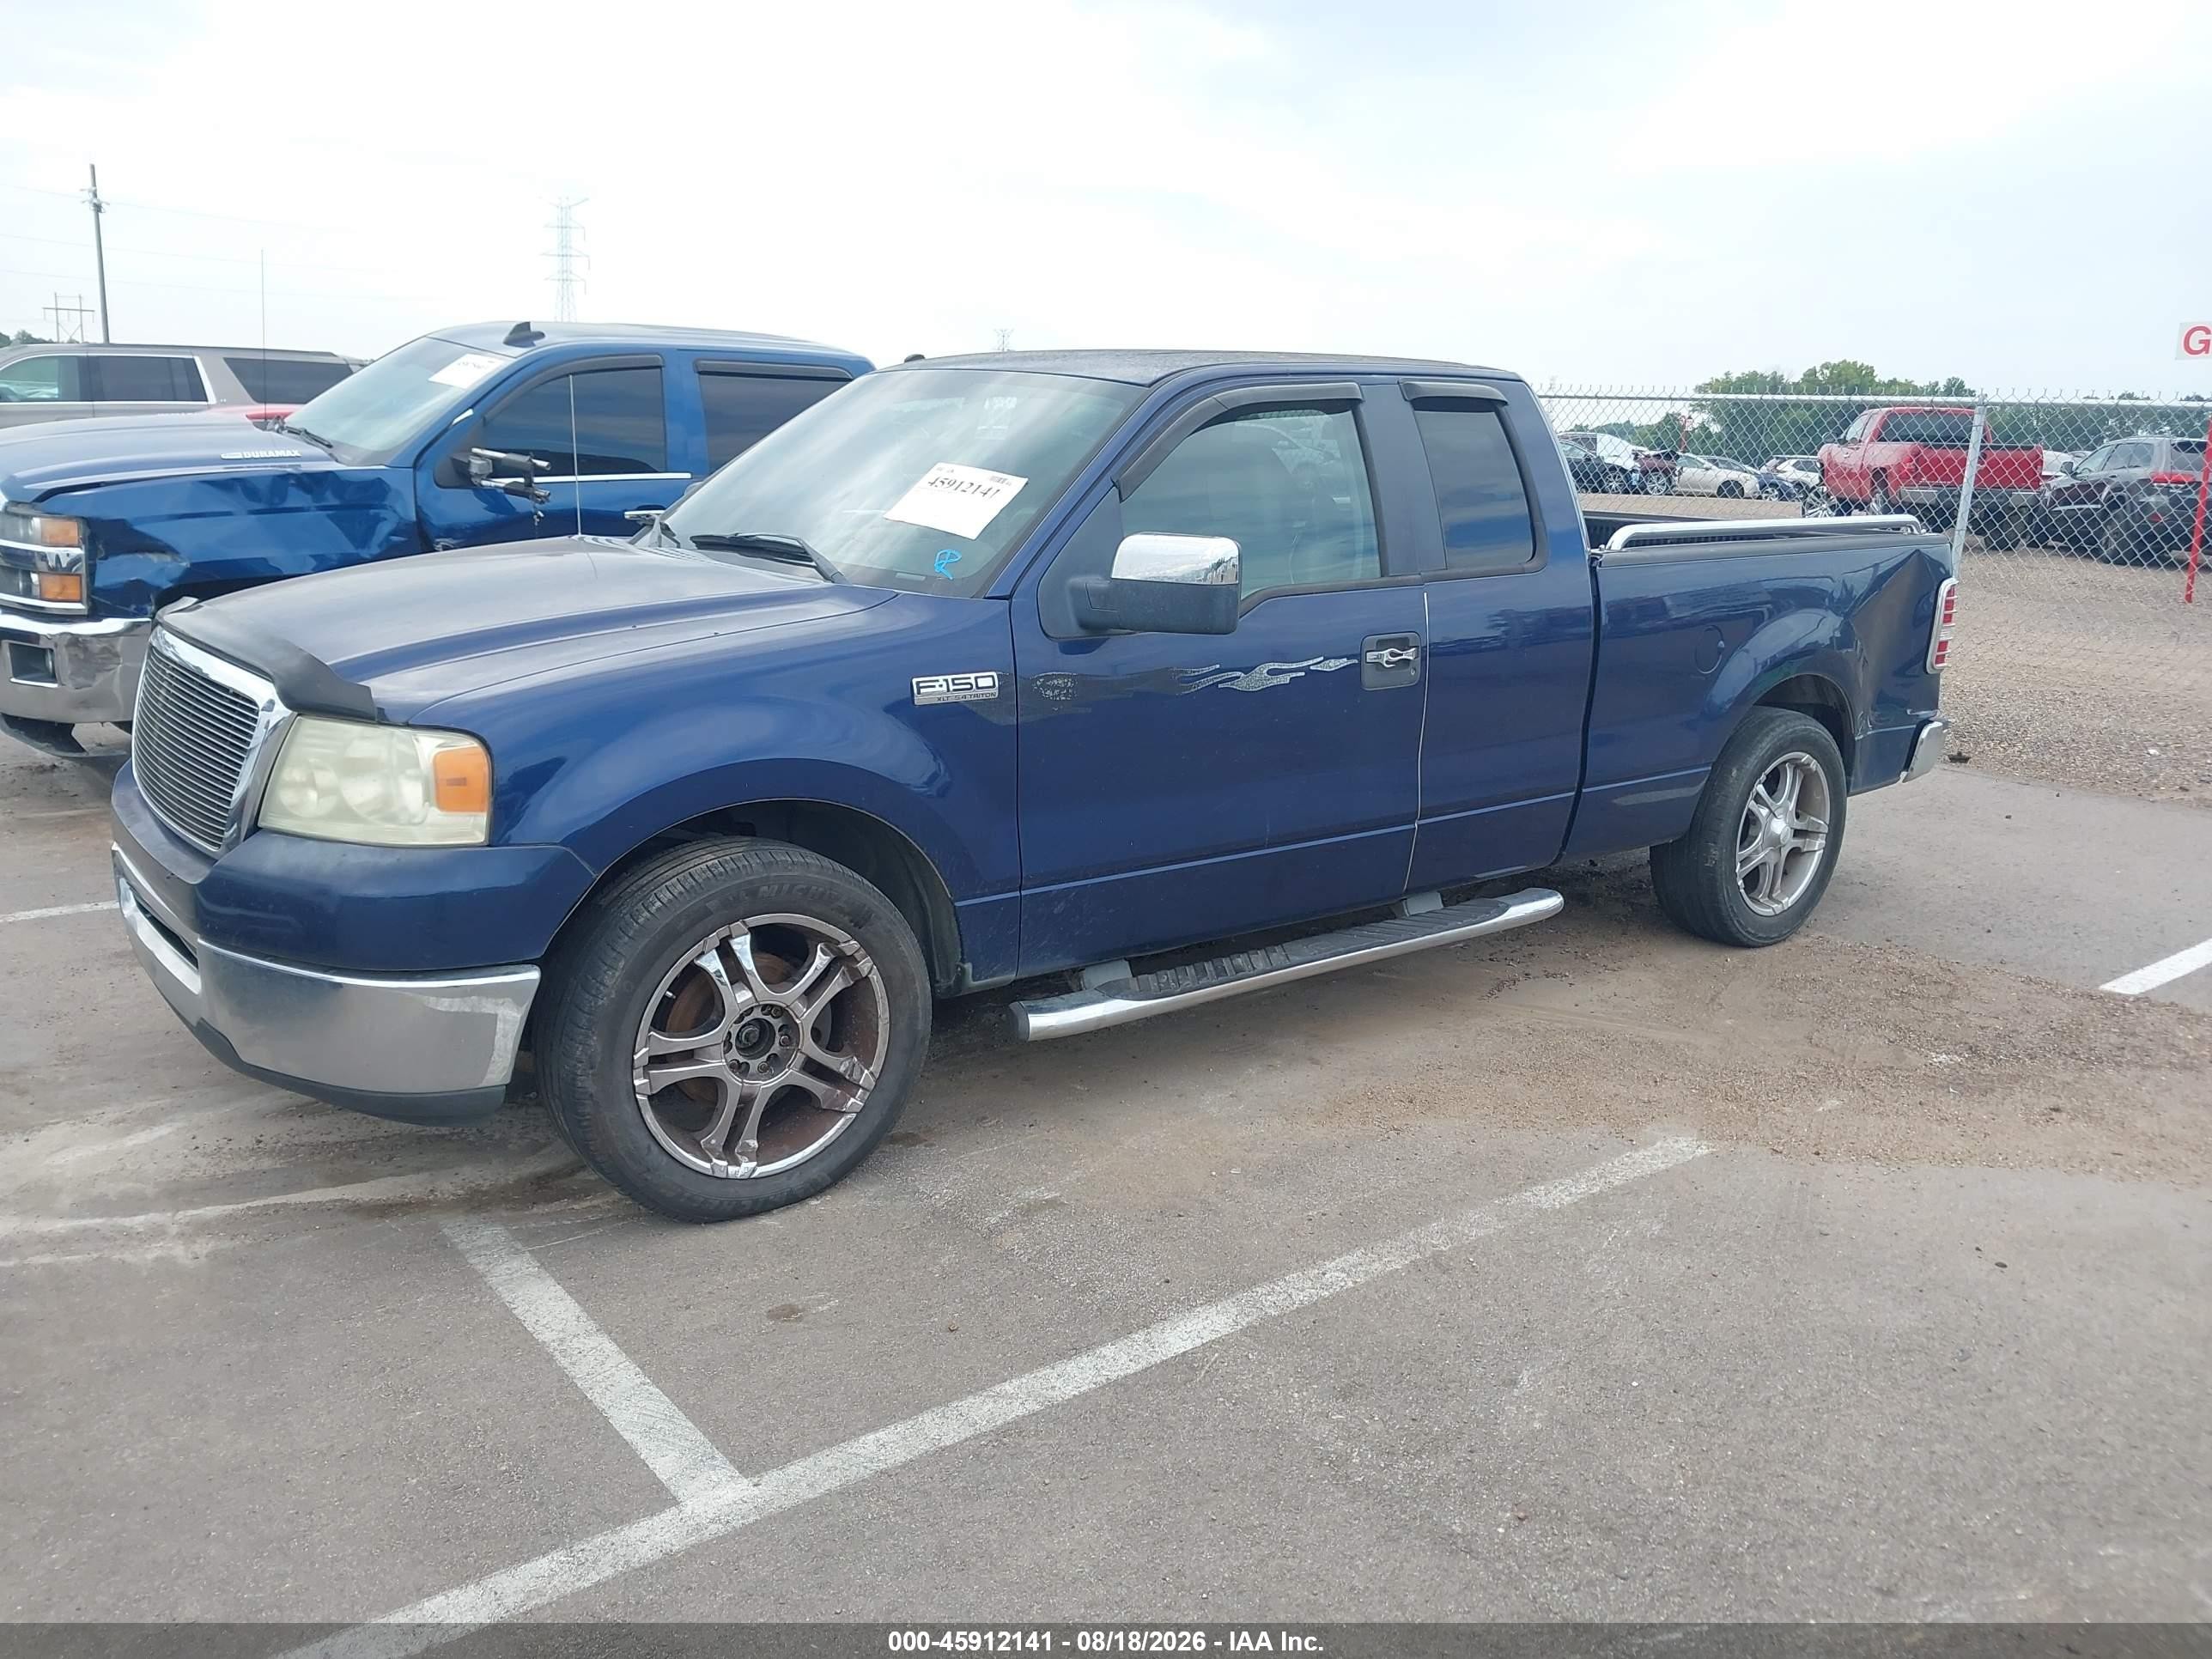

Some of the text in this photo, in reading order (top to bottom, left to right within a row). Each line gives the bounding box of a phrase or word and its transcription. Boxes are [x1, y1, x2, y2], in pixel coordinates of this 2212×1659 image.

[2184, 325, 2211, 355] G
[927, 476, 1001, 499] 45912141
[969, 691, 997, 700] TRITON
